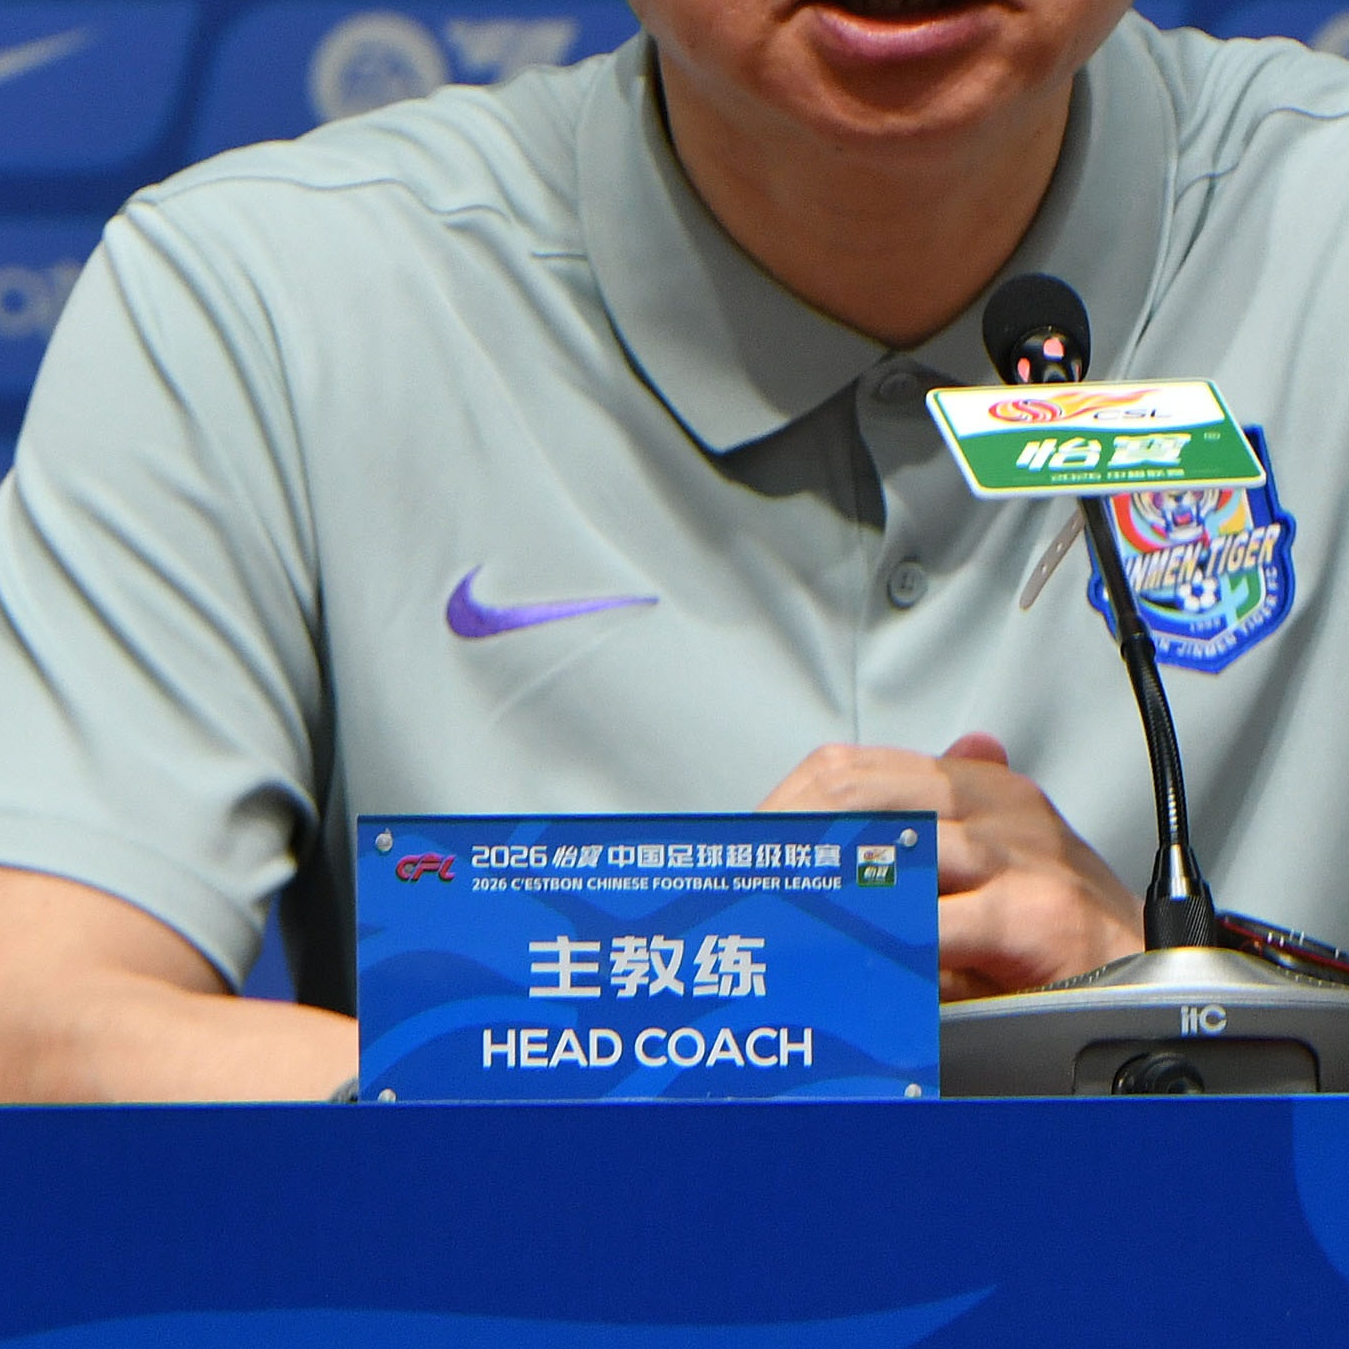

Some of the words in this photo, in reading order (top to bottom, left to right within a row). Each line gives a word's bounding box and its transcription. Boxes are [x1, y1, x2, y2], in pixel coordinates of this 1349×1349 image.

[1206, 522, 1281, 579] TIGER
[472, 877, 508, 891] 2026
[510, 877, 583, 891] C'ESTBON
[586, 876, 649, 890] CHINESE
[652, 876, 729, 890] FOOTBALL
[732, 876, 781, 890] SUPER
[784, 876, 842, 890] LEAGUE
[528, 934, 767, 998] 主教练
[482, 1027, 623, 1068] HEAD
[634, 1026, 813, 1068] COACH
